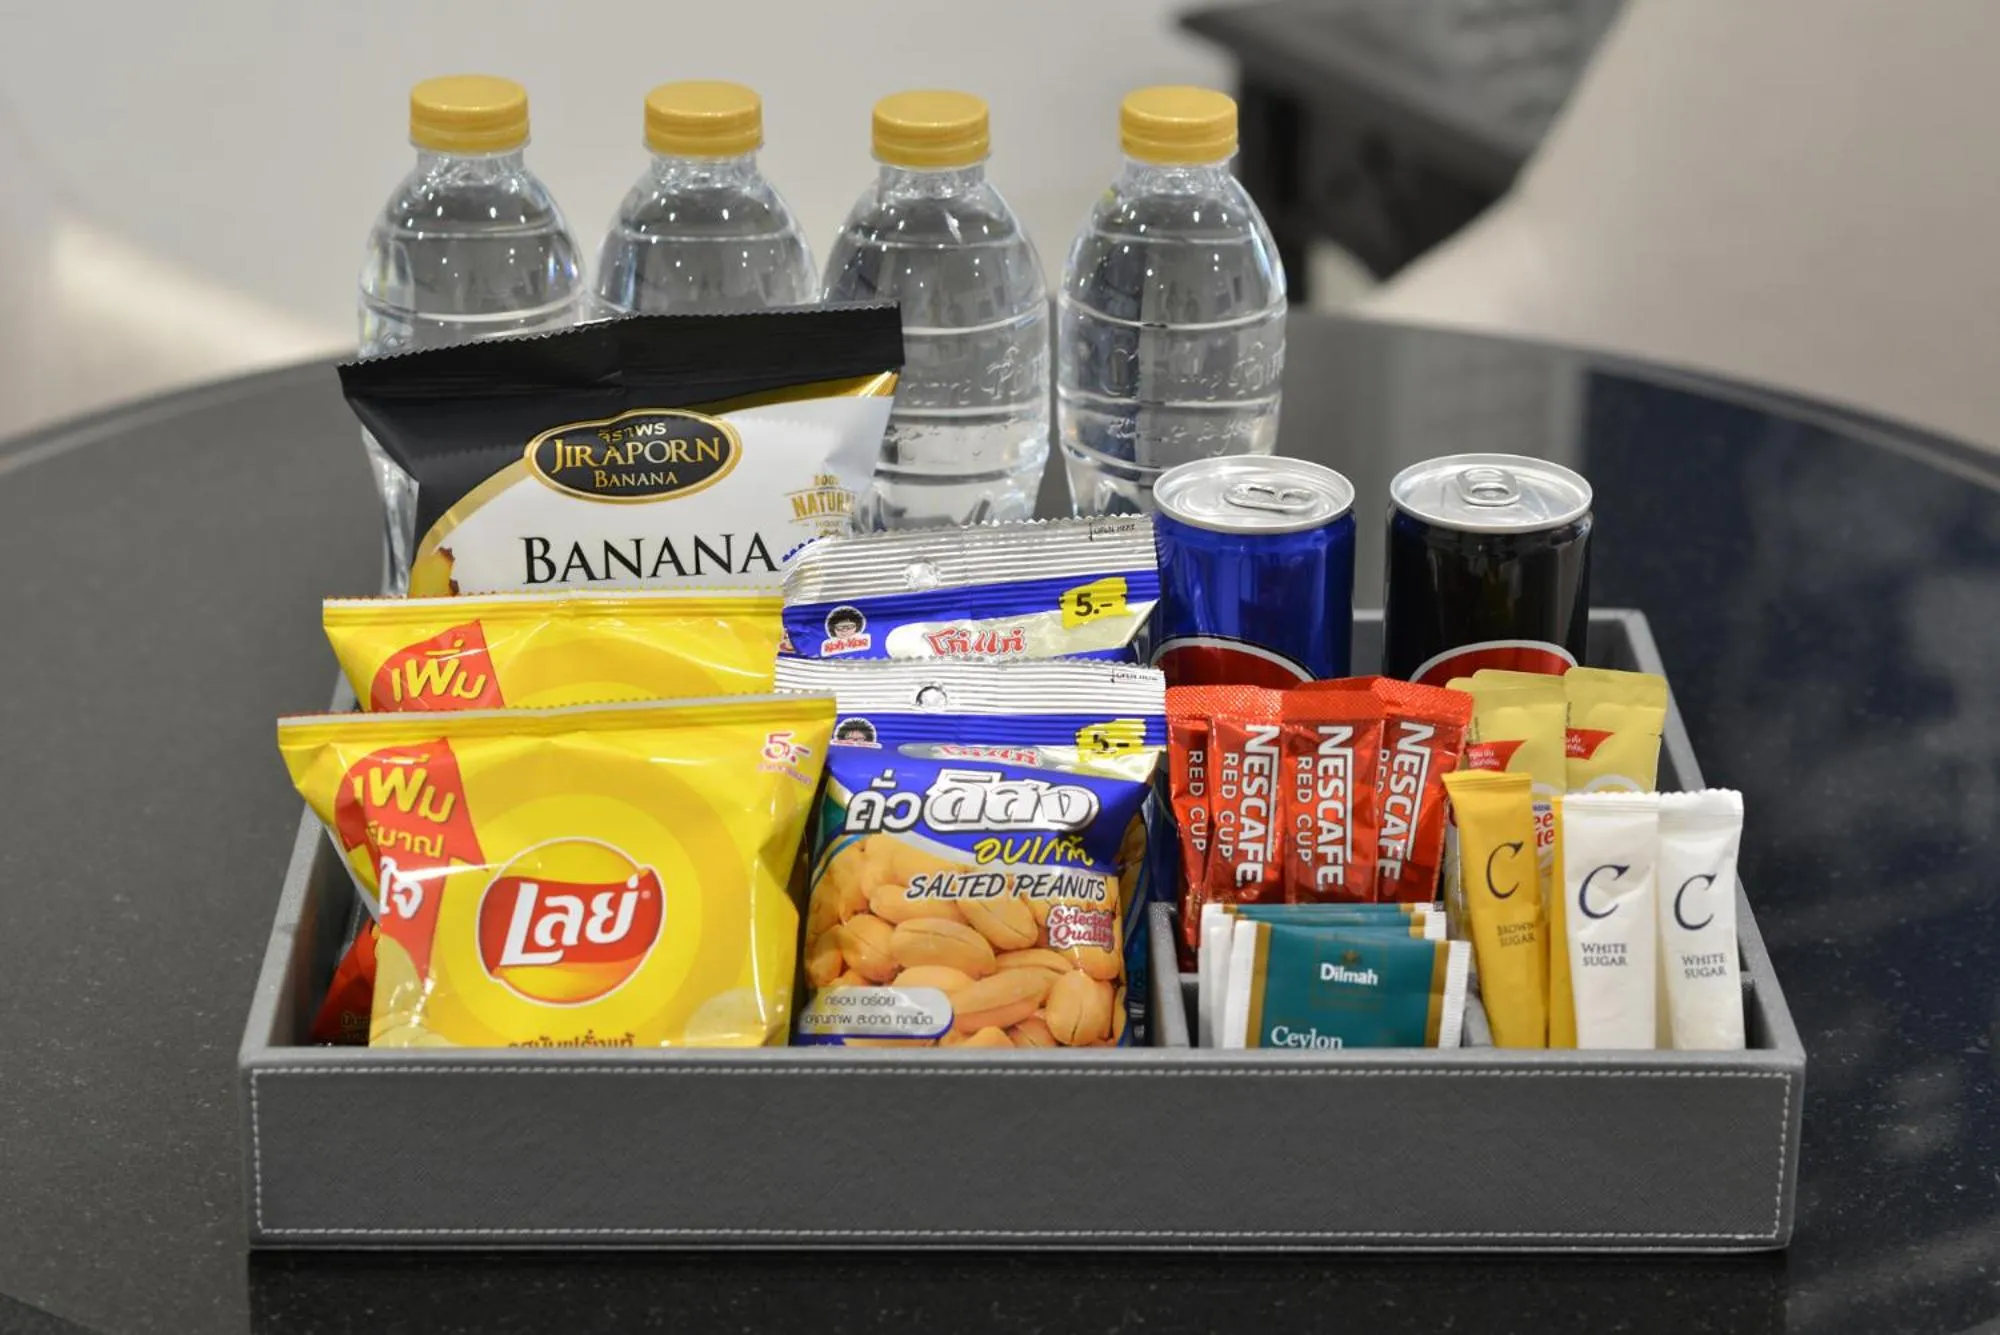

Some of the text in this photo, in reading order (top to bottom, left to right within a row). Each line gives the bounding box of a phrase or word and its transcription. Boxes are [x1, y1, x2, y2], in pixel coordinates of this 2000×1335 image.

[552, 436, 720, 474] JIRAPORN
[594, 469, 678, 488] BANANA
[519, 532, 781, 584] BANANA
[391, 638, 486, 703] เพิ่ม
[1188, 750, 1207, 852] RED CUP
[1218, 752, 1239, 861] RED CUP
[1296, 756, 1313, 862] RED CUP
[906, 873, 1105, 901] SALTED PEANUTS
[1486, 841, 1524, 899] C
[1578, 864, 1631, 919] C
[1674, 873, 1717, 930] C
[1581, 942, 1628, 955] WHITE
[1582, 955, 1628, 967] SUGAR
[1681, 953, 1726, 966] WHITE
[1320, 962, 1379, 986] Dilmah
[1684, 965, 1727, 979] SUGAR
[1270, 1025, 1343, 1049] Ceylon
